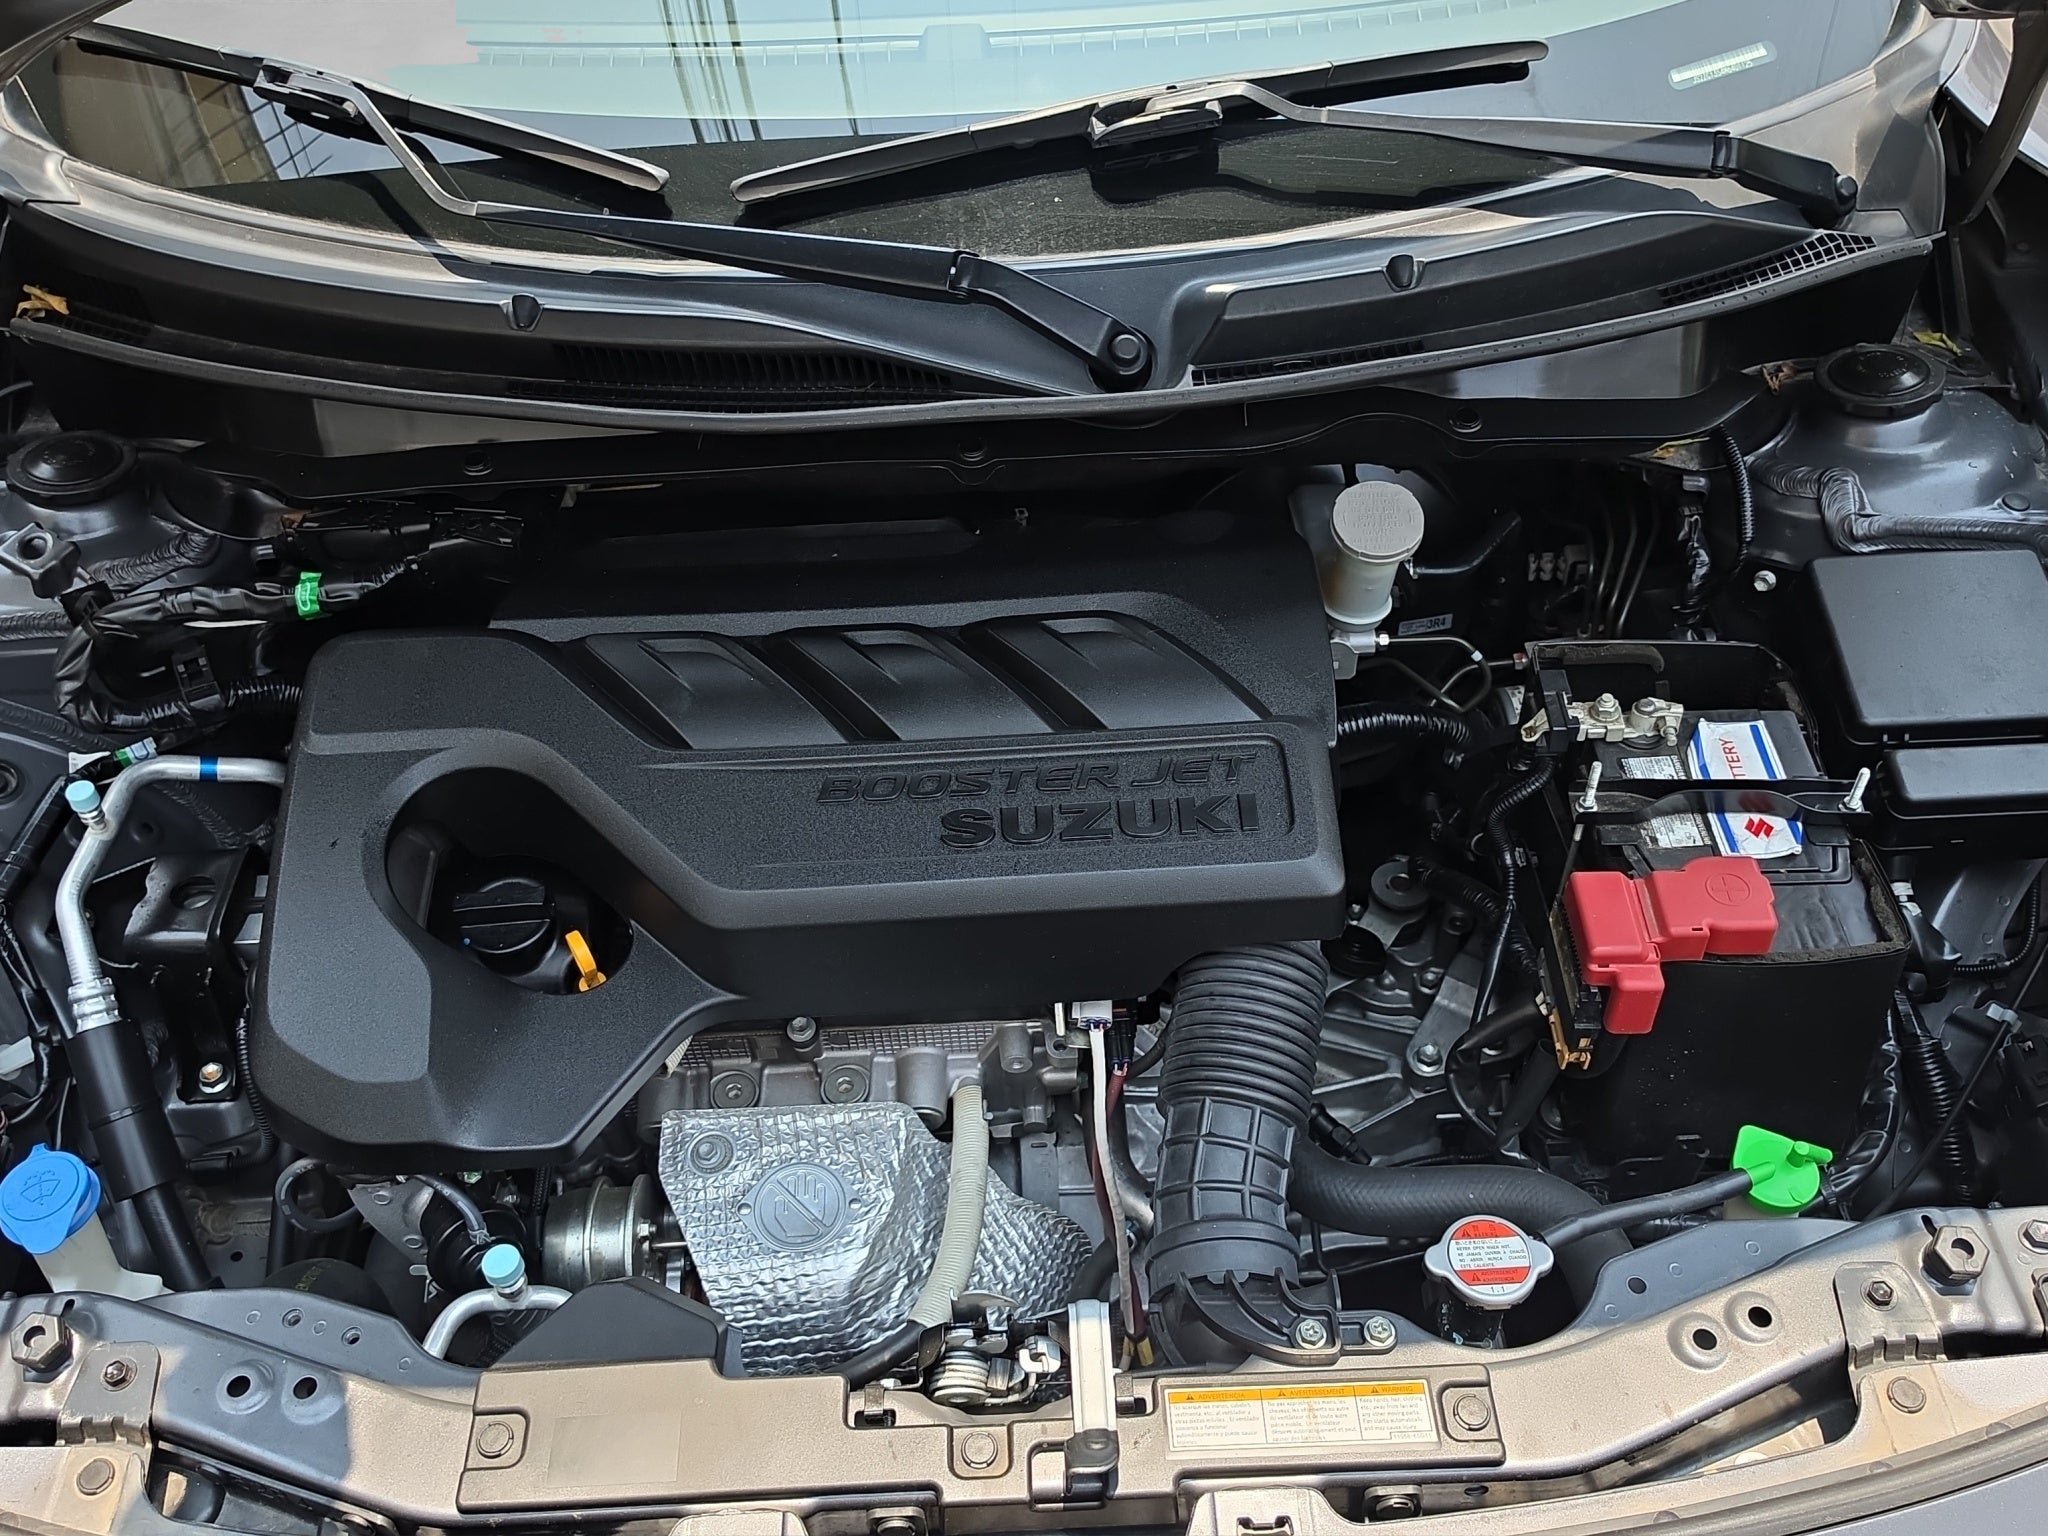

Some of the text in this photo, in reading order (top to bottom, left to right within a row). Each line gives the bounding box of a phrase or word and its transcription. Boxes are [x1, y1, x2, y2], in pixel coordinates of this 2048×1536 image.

[817, 752, 1257, 803] BOOSTER JET
[1718, 737, 1746, 779] TTERY
[940, 792, 1260, 848] SUZUKI
[1290, 1388, 1345, 1397] AVERTISSEMENT
